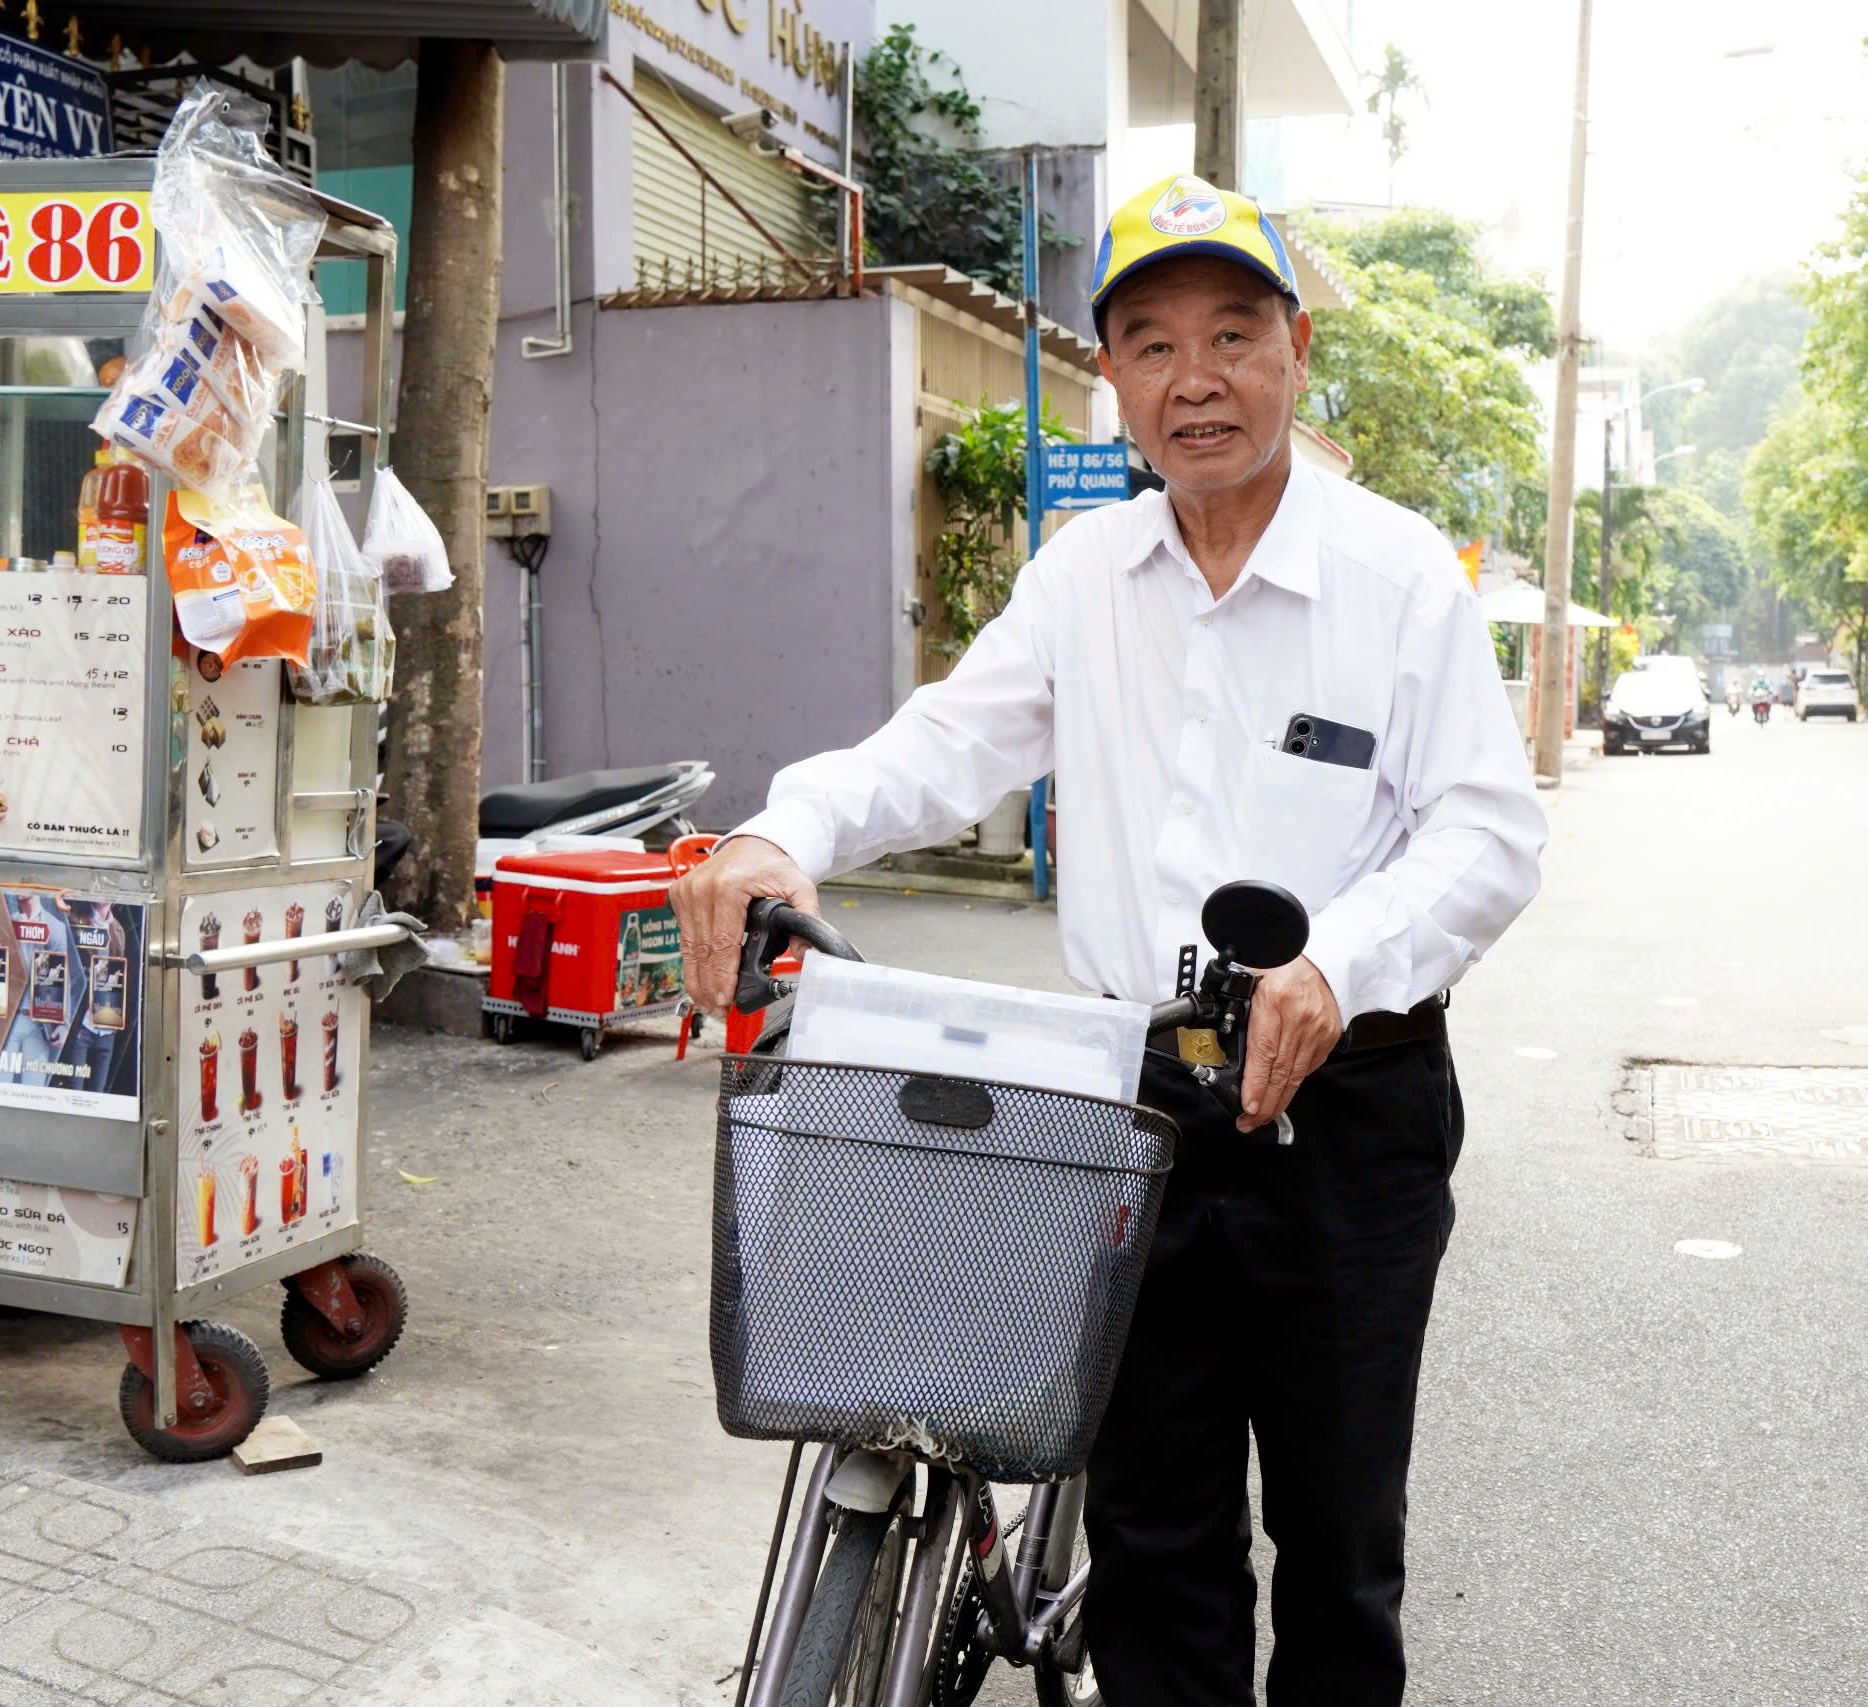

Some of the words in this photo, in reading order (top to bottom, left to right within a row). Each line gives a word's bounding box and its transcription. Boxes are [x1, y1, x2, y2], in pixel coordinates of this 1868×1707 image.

[63, 103, 104, 156] VY
[28, 202, 142, 283] 86
[1082, 453, 1124, 468] 86/56
[1080, 474, 1125, 491] QUANG
[107, 596, 131, 605] 20
[7, 627, 41, 638] XÀO
[74, 632, 90, 641] 15
[85, 668, 99, 680] 15
[113, 670, 129, 679] 12
[67, 681, 89, 689] Mung
[7, 736, 39, 747] CHẢ
[112, 744, 128, 752] 10
[27, 822, 40, 830] CÓ
[44, 823, 65, 832] BÁN
[68, 825, 103, 835] THUỐC
[107, 827, 119, 836] LÁ
[20, 925, 45, 940] THƠM
[15, 1208, 41, 1220] SỮA
[48, 1212, 66, 1224] ĐÁ
[118, 1221, 129, 1234] 15
